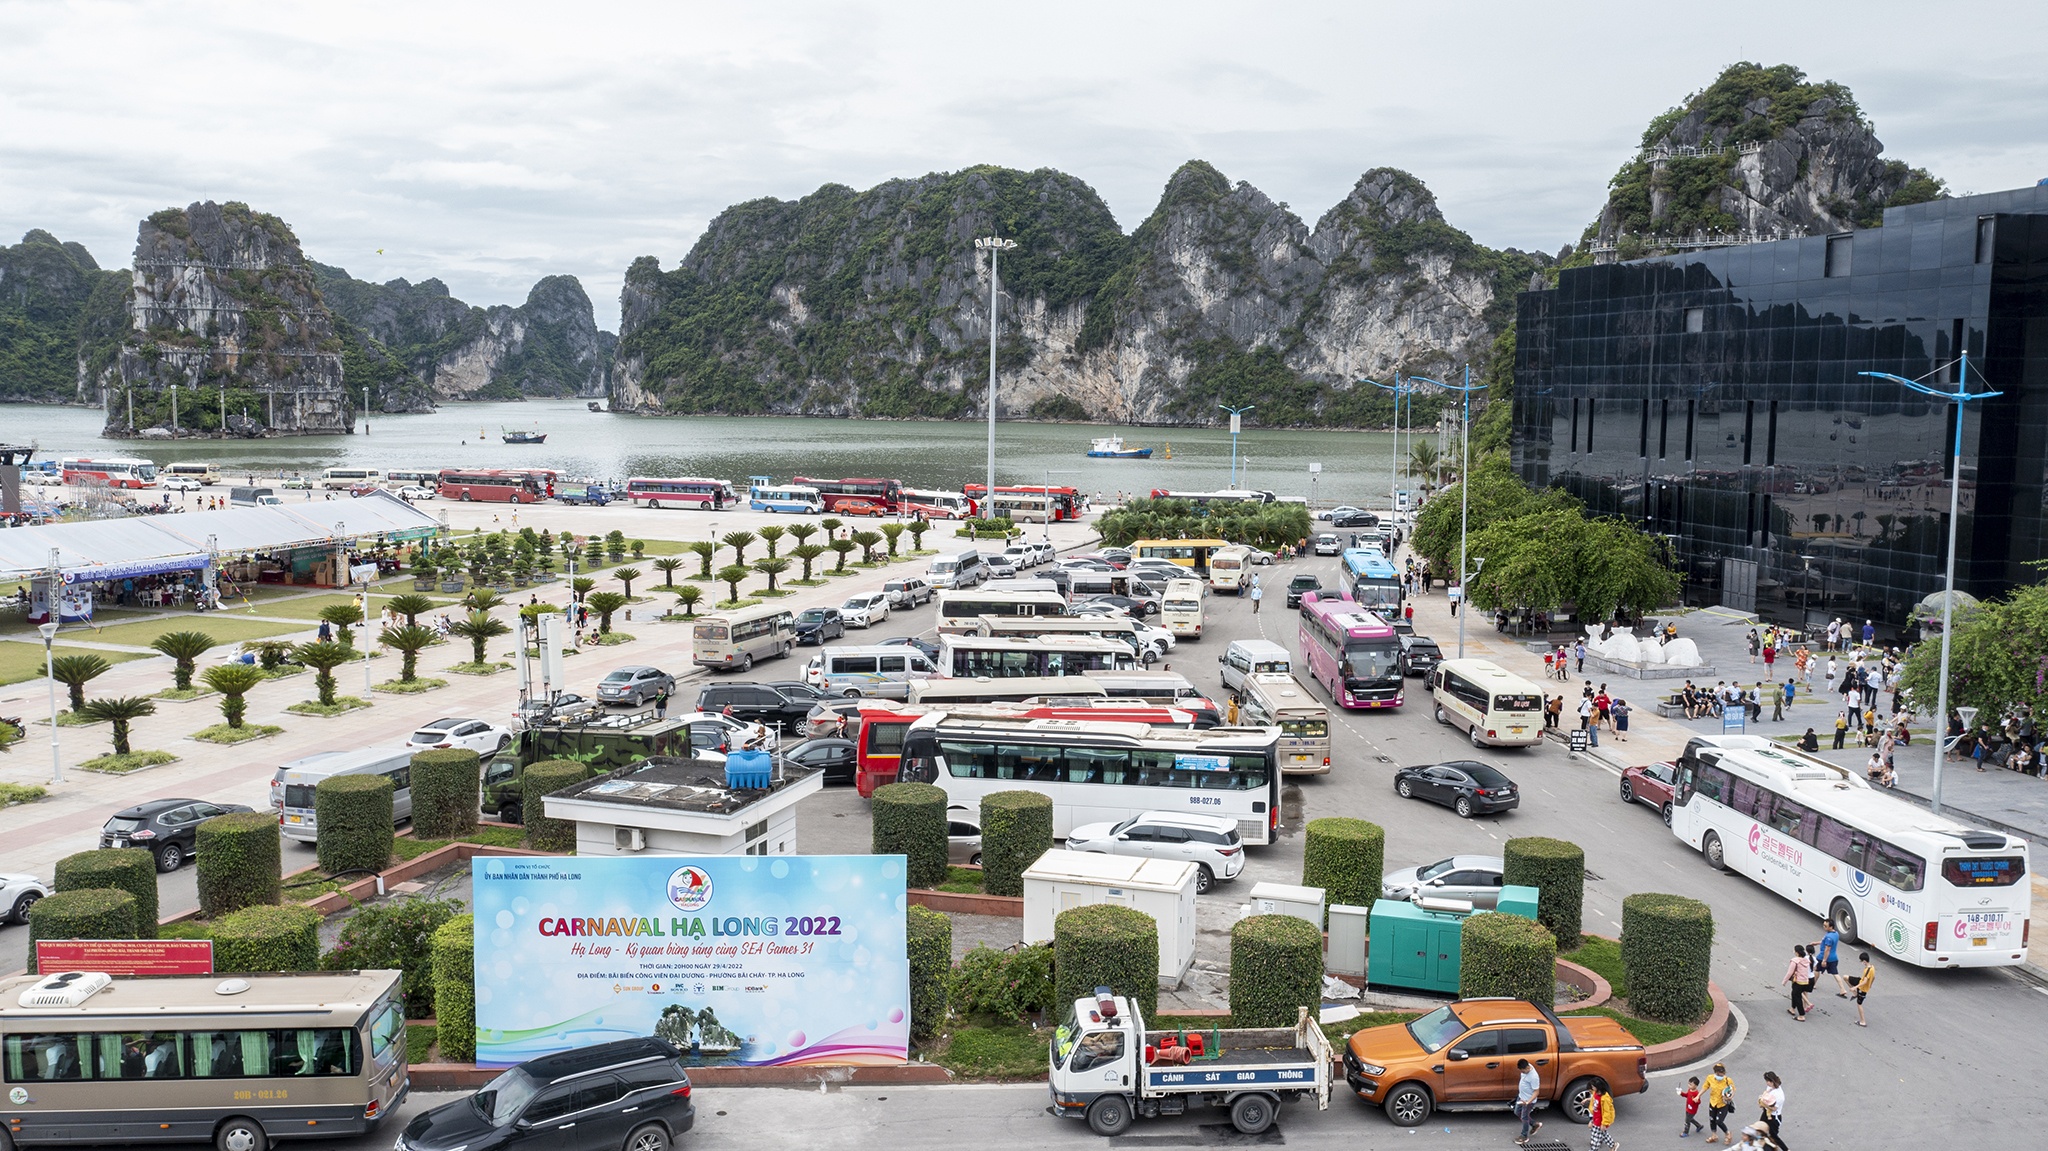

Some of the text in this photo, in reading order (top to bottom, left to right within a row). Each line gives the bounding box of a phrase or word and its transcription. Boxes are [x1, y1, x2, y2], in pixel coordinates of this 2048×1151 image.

[1761, 851, 1788, 871] Goldenbell
[504, 872, 518, 880] NHÂN
[519, 872, 530, 880] DÂN
[531, 872, 548, 880] THÀNH
[549, 871, 560, 880] PHỐ
[560, 873, 567, 881] HẠ
[1967, 914, 2004, 923] 14B-010.11
[538, 916, 842, 941] CARNAVAL HẠ LONG 2022
[571, 942, 586, 959] Hạ
[588, 942, 612, 958] Long
[625, 942, 639, 959] Kỳ
[640, 945, 664, 958] quan
[666, 942, 690, 958] bừng
[691, 942, 714, 958] sáng
[715, 942, 738, 958] cùng
[741, 942, 764, 955] SEA
[767, 942, 799, 955] Games
[801, 942, 815, 955] 31
[590, 971, 607, 979] ĐIỂM:
[620, 971, 634, 979] BIỂN
[669, 972, 680, 980] ĐẠI
[1162, 1070, 1304, 1082] CẢNH SÁT GIAO THÔNG
[234, 1090, 251, 1099] 20B
[258, 1089, 288, 1099] 021.26
